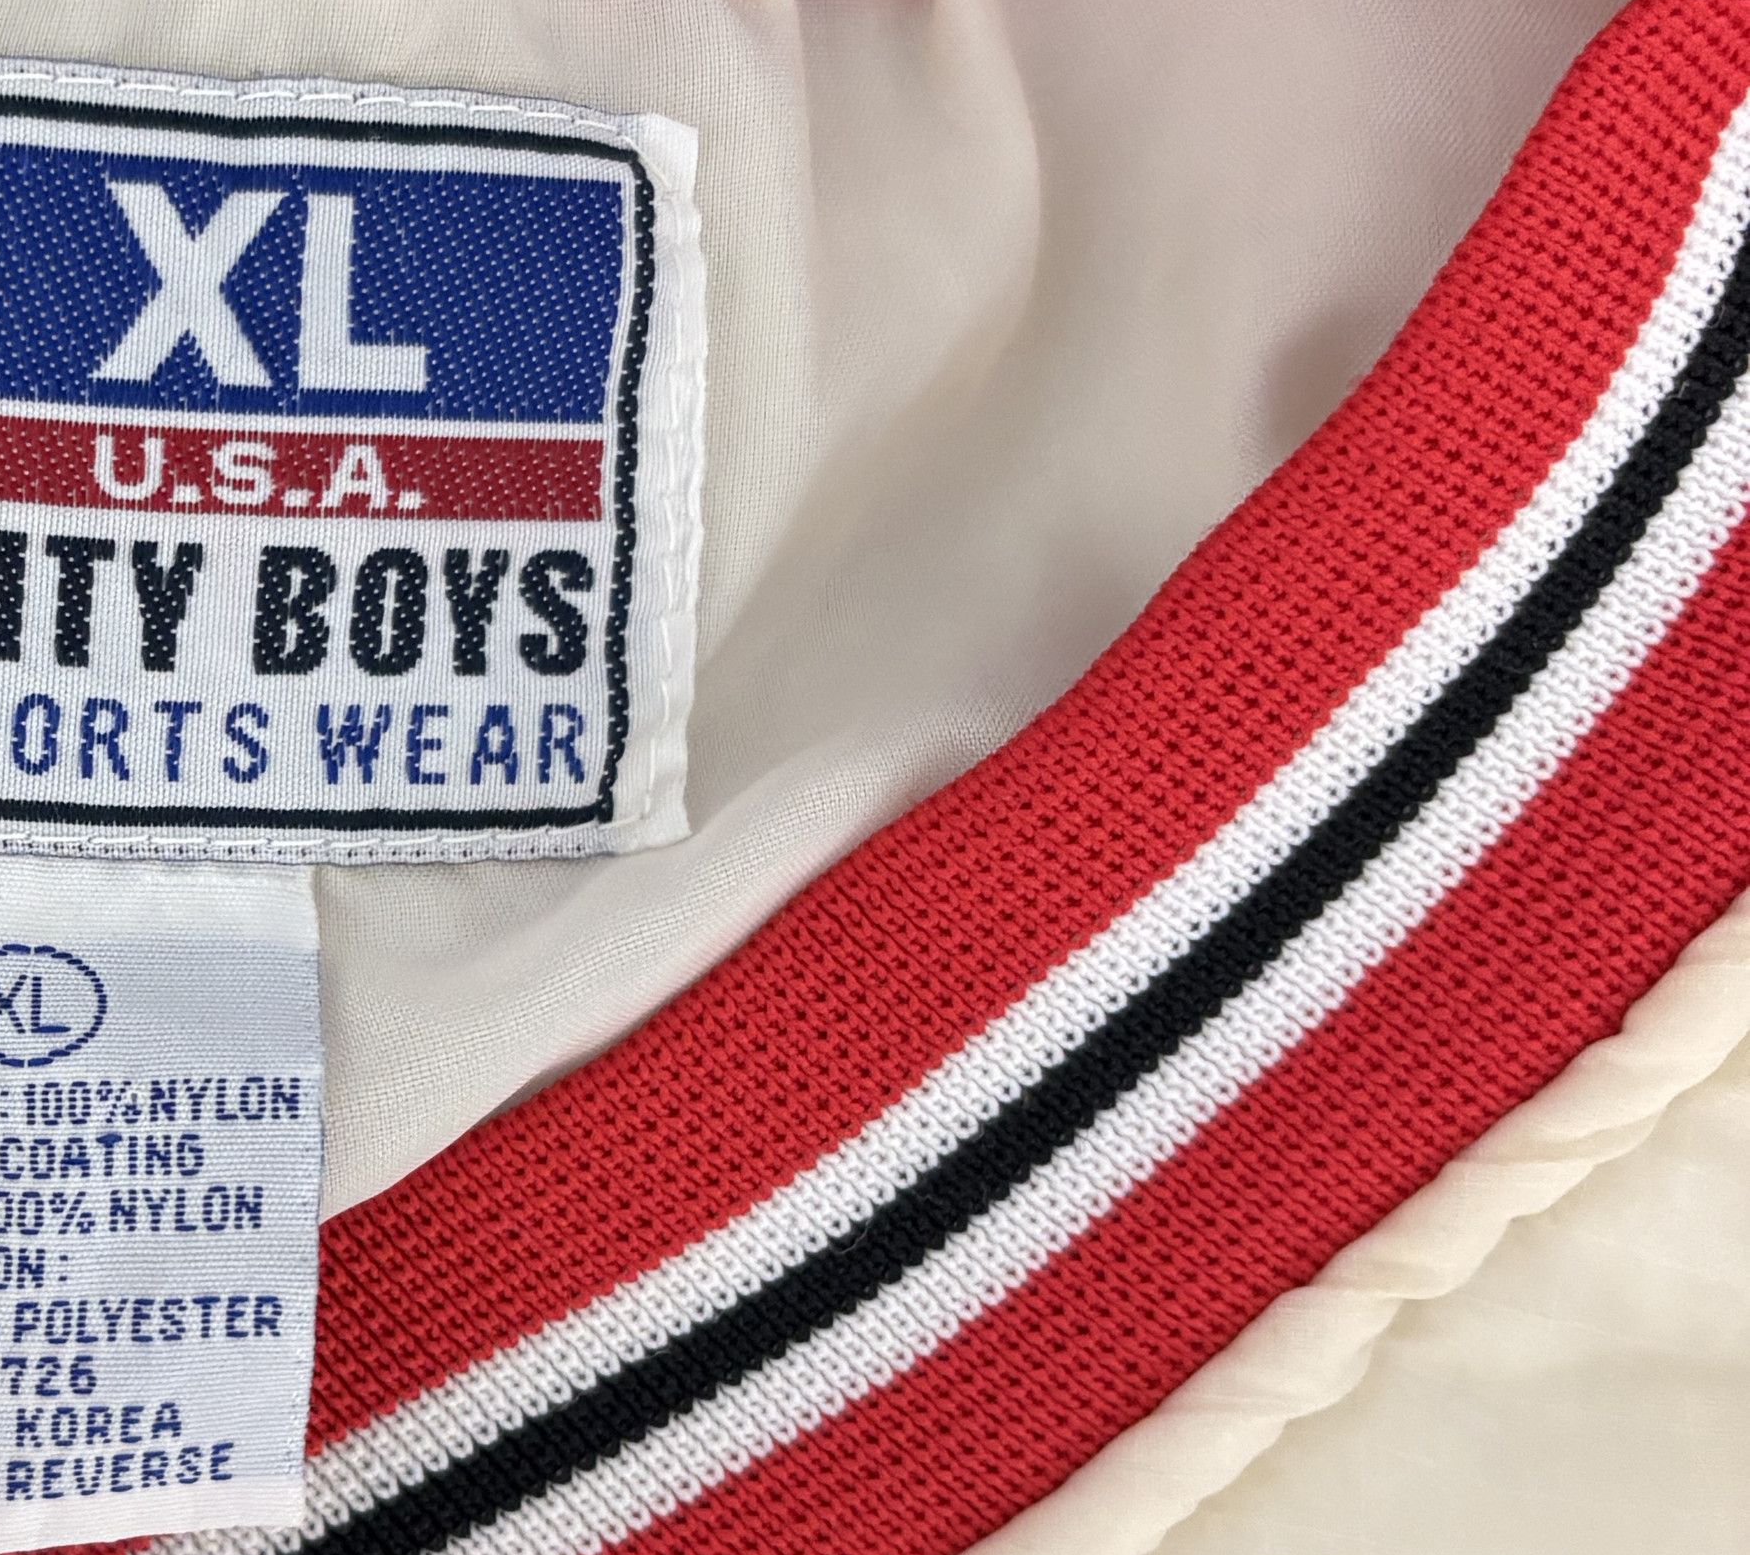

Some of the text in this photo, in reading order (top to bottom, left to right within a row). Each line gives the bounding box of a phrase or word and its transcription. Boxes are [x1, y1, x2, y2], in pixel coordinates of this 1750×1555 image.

[90, 177, 433, 395] XL
[91, 431, 427, 510] U.S.A.
[251, 544, 593, 677] BOYS
[314, 702, 589, 787] WEAR
[149, 1076, 301, 1123] NYLON
[109, 1185, 264, 1233] NYLON
[13, 1296, 283, 1345] POLYESTER
[15, 1403, 183, 1447] KOREA
[6, 1442, 235, 1502] REVERSE
